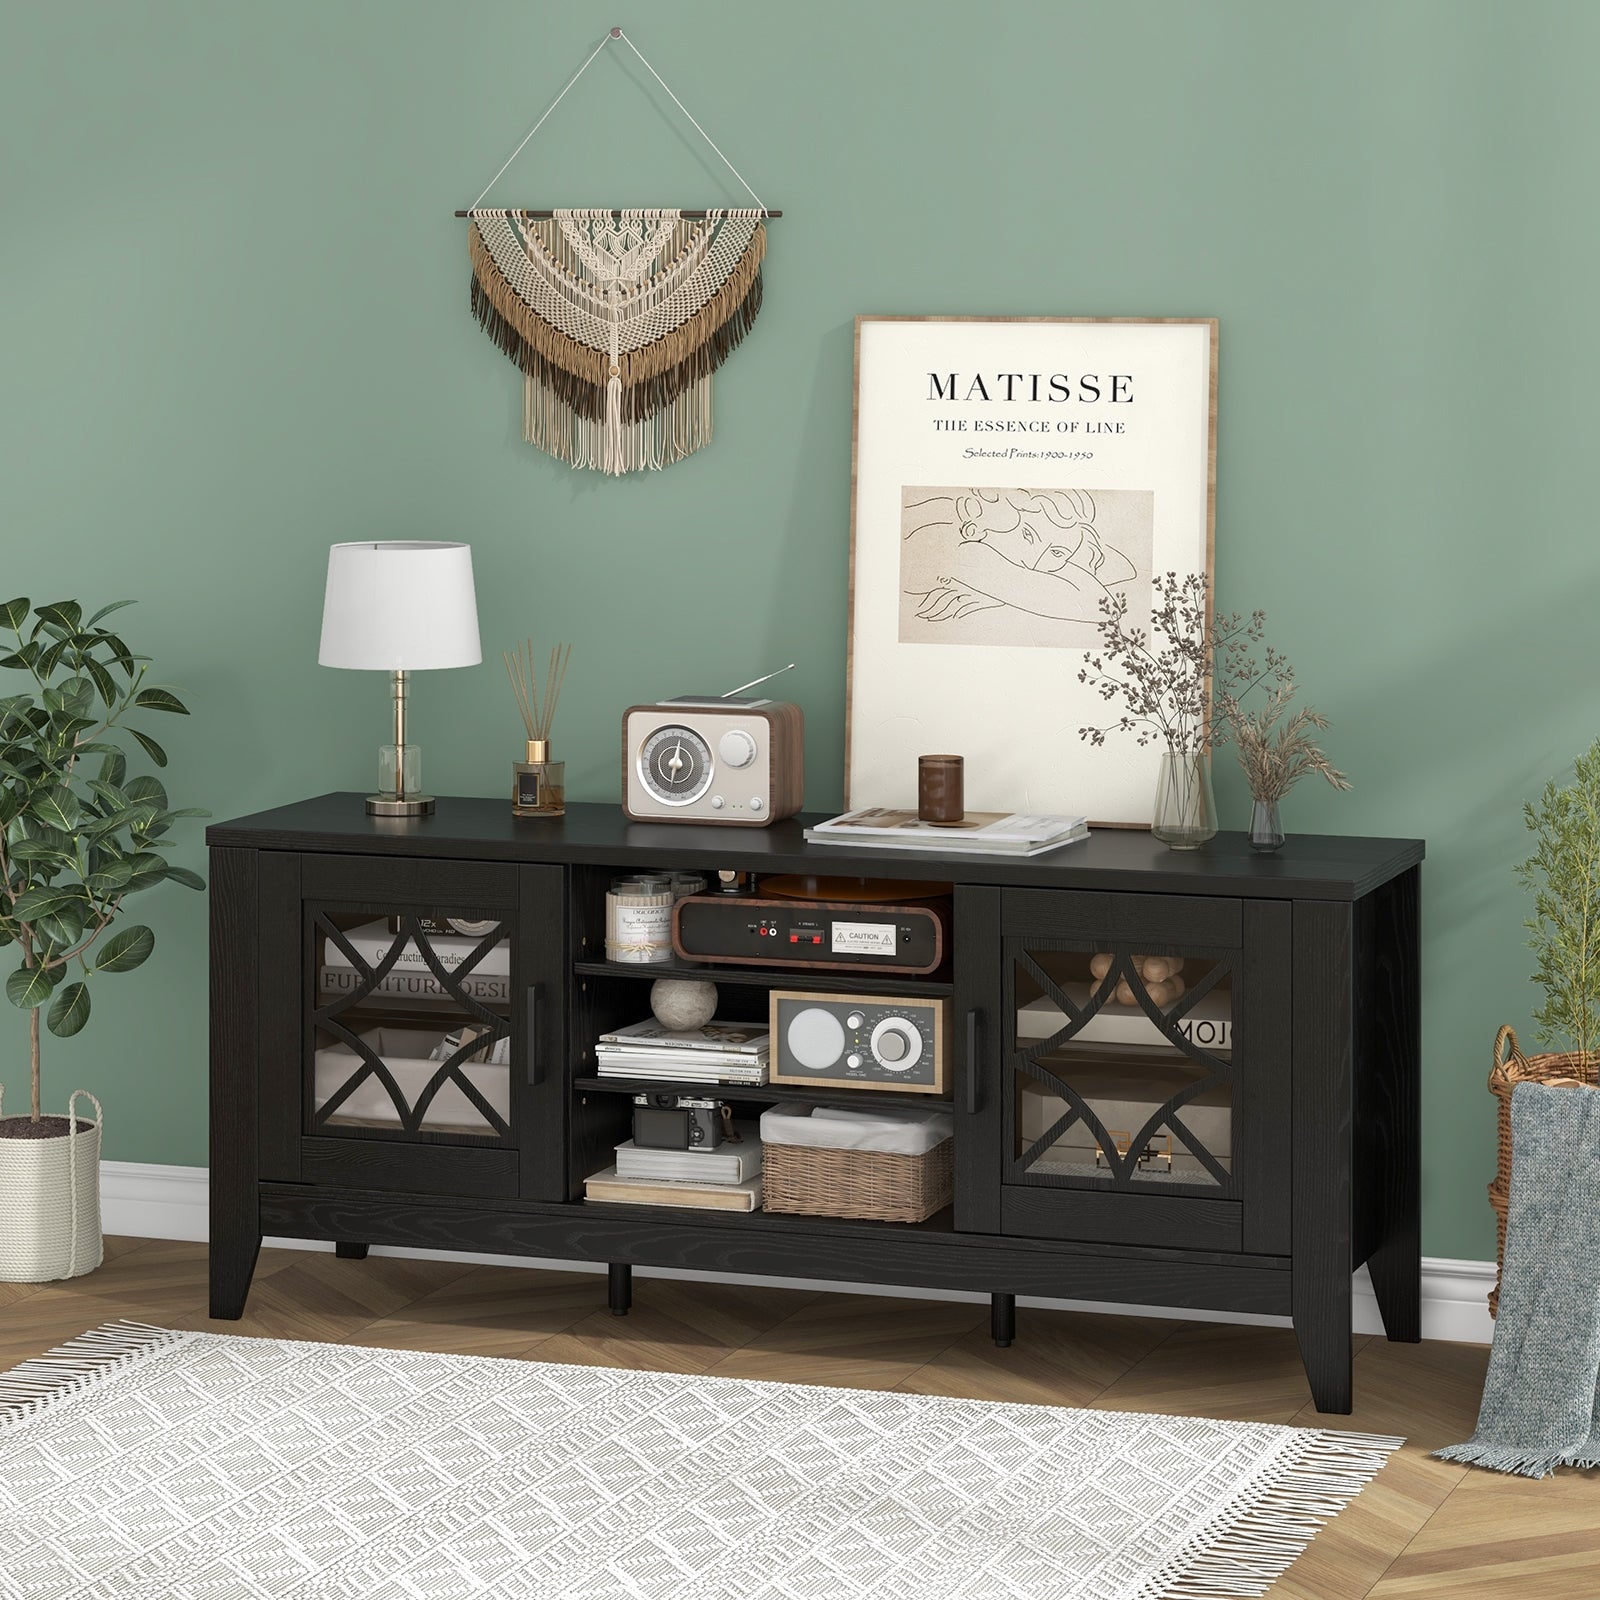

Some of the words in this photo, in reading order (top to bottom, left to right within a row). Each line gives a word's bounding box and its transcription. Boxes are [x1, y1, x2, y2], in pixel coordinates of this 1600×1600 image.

[926, 372, 1134, 403] MATISSE
[933, 419, 968, 432] THE
[974, 420, 1051, 433] ESSENCE
[1056, 421, 1080, 434] OF
[1085, 422, 1126, 434] LINE
[962, 447, 1008, 460] Selected
[849, 932, 879, 940] CAUTION
[1175, 1020, 1232, 1045] MOJ
